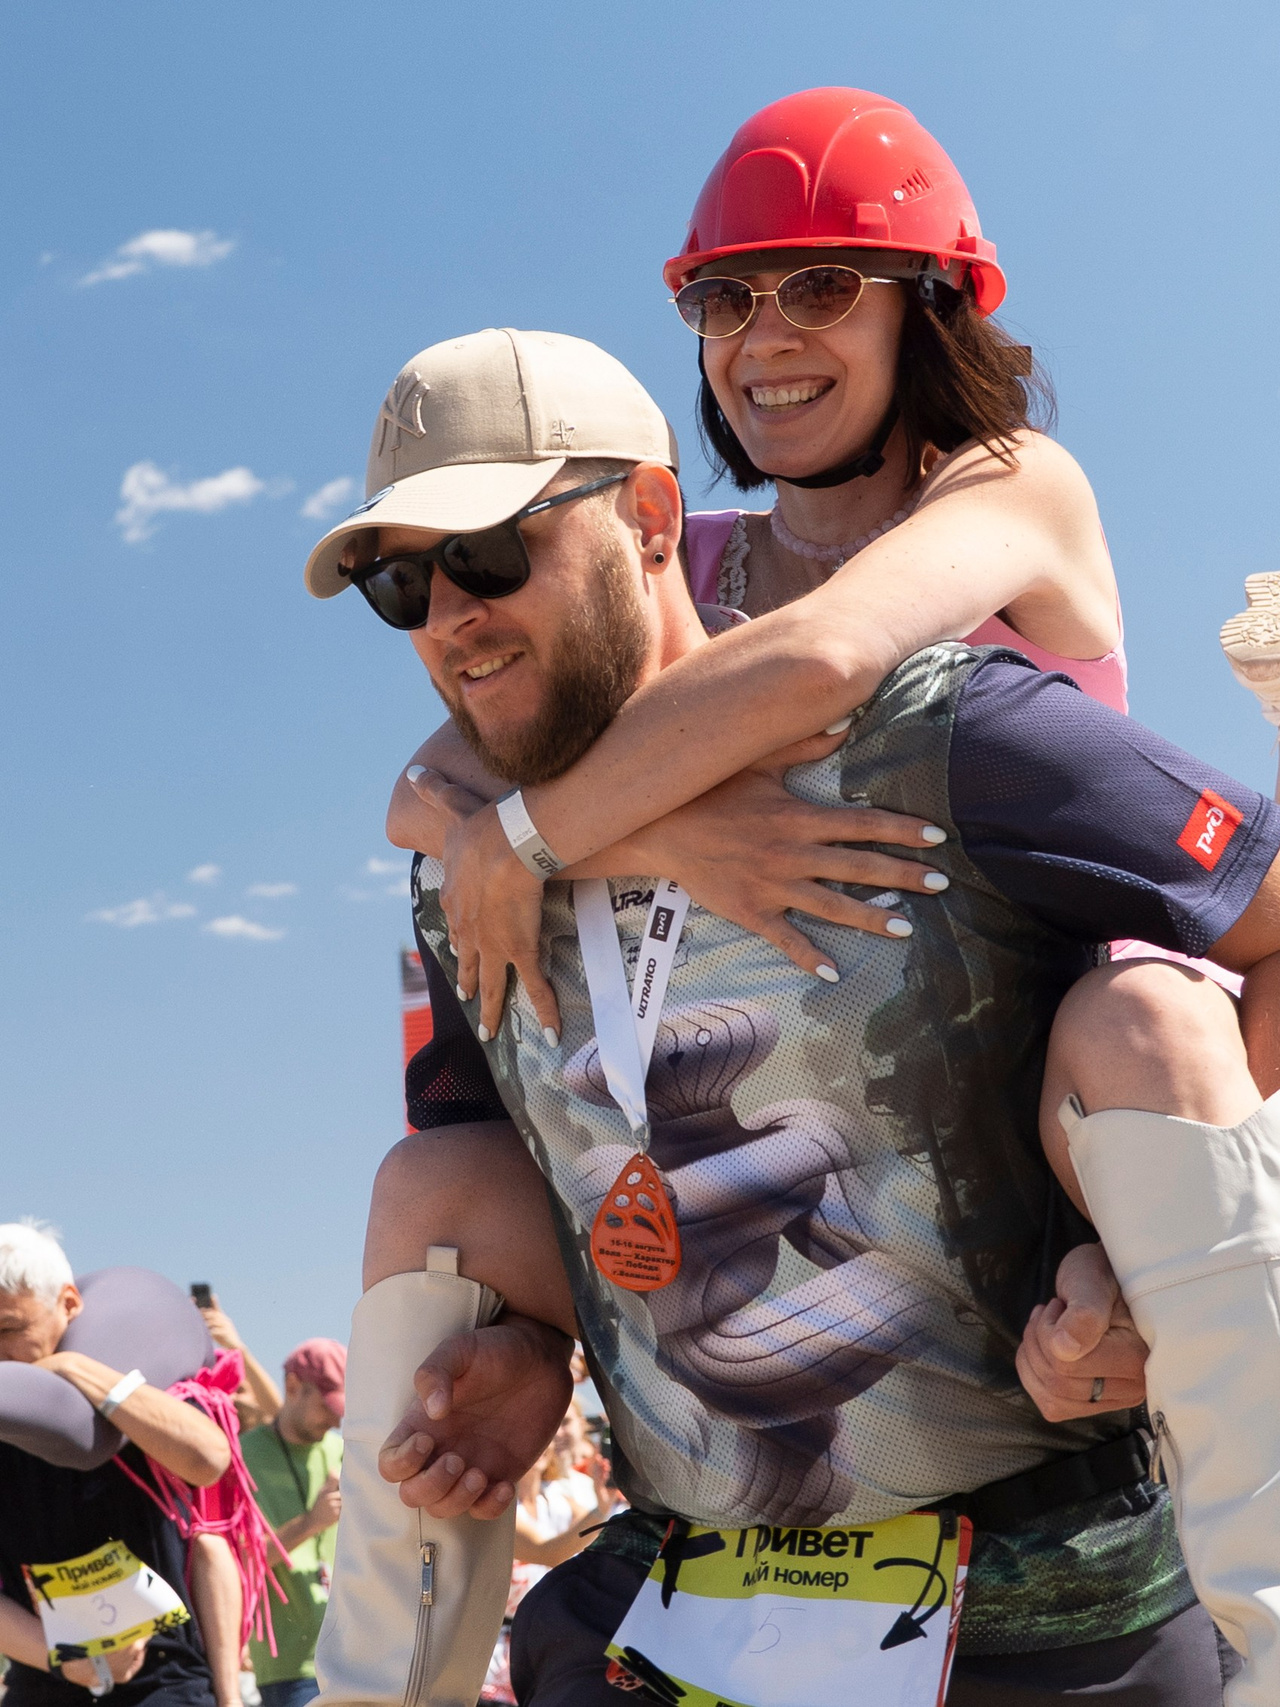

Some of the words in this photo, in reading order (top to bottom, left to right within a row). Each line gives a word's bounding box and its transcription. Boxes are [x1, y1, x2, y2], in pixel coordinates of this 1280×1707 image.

[56, 1550, 121, 1582] Привет
[773, 1566, 849, 1592] номер
[91, 1594, 118, 1626] 3
